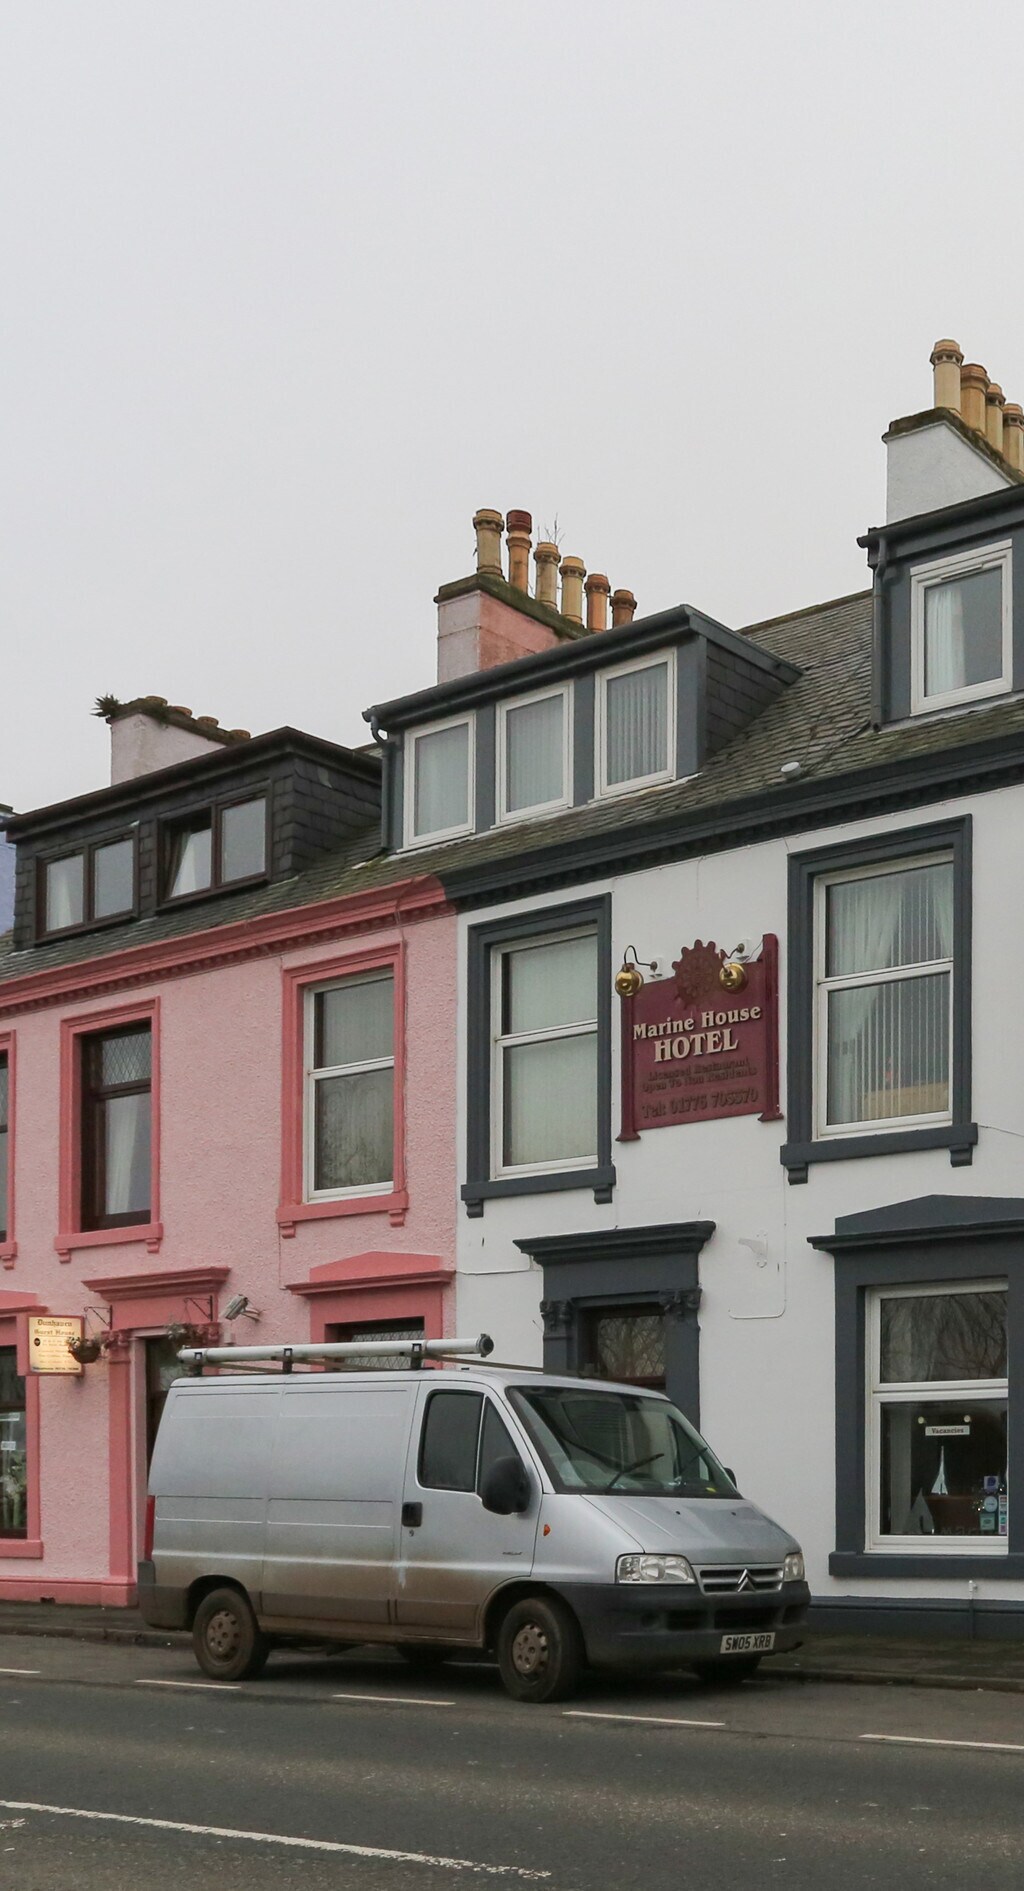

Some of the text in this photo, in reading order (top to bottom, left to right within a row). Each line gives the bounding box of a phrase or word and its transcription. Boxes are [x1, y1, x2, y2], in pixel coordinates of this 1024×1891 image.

[633, 1005, 761, 1041] Marine House
[654, 1028, 739, 1063] HOTEL
[753, 1634, 772, 1649] XRB
